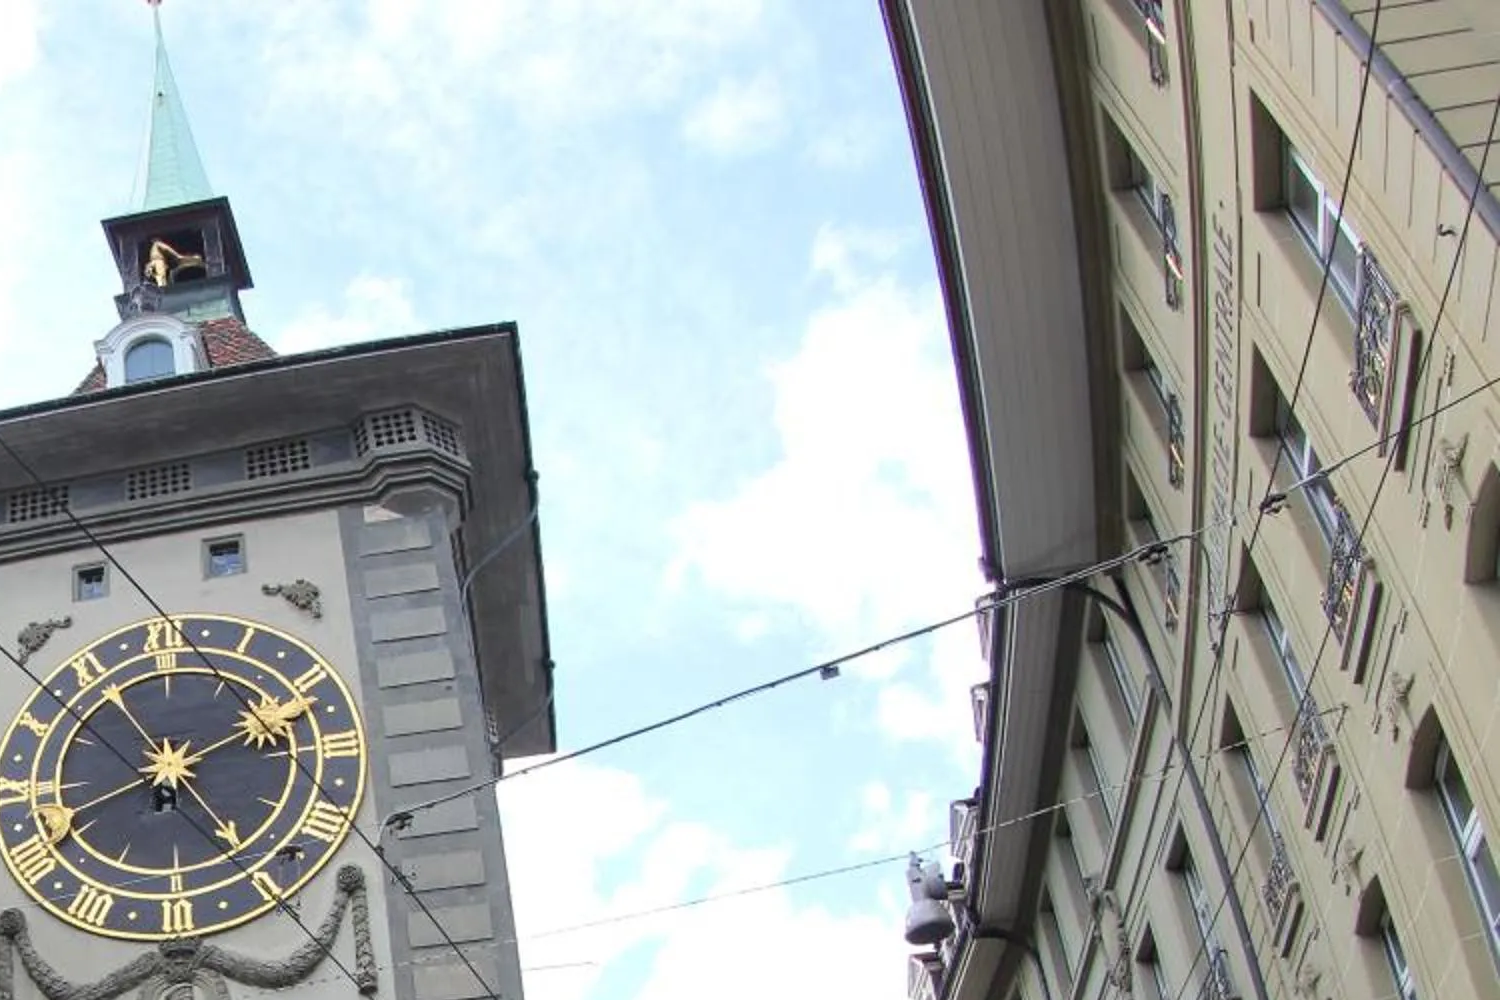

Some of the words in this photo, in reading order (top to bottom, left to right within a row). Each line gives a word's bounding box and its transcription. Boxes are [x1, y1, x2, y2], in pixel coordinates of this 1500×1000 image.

[143, 619, 184, 652] XII
[237, 627, 254, 653] I
[71, 652, 107, 688] XI
[294, 663, 327, 693] II
[19, 711, 49, 737] X
[322, 729, 359, 758] III
[301, 800, 348, 842] IIII
[10, 833, 56, 885] VIII
[251, 872, 282, 900] V
[67, 884, 114, 926] VII
[162, 899, 195, 932] VI
